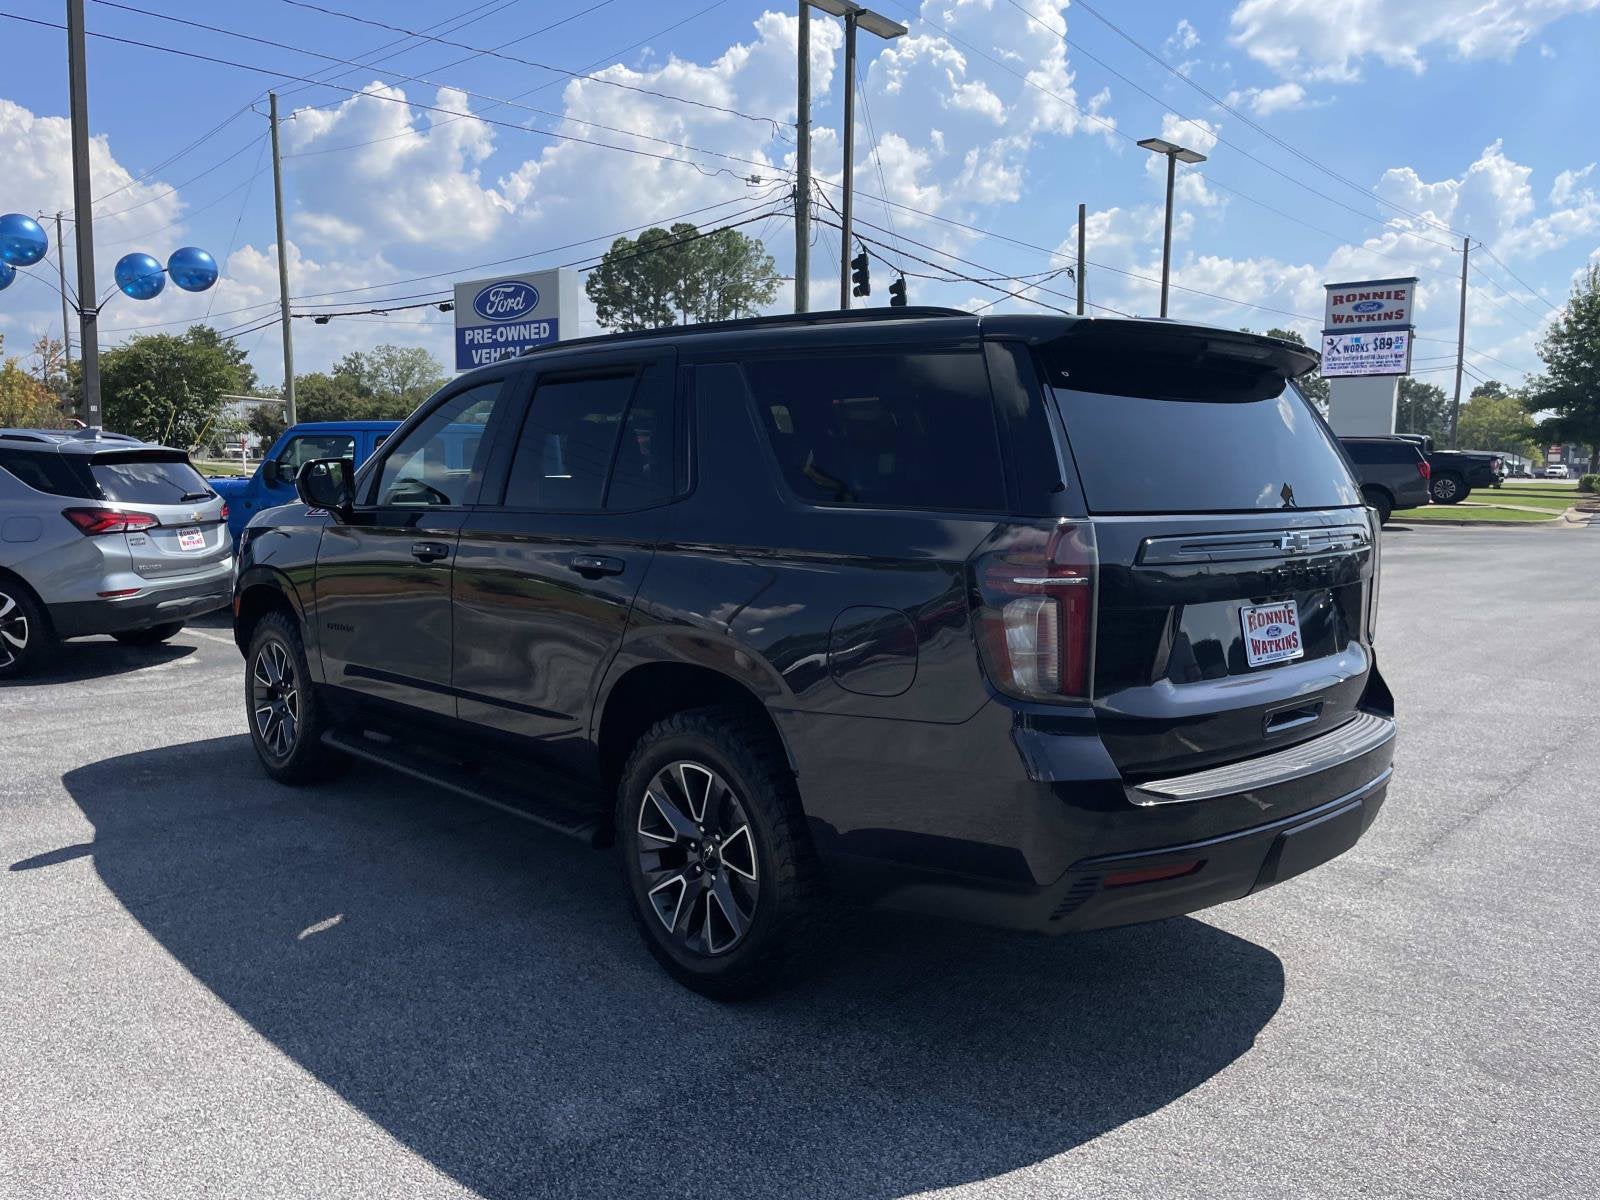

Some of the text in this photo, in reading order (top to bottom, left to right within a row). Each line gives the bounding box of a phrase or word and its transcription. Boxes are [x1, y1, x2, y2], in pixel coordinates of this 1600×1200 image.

[486, 286, 526, 315] Ford
[1332, 289, 1406, 306] RONNIE
[1331, 309, 1405, 325] WATKINS
[464, 322, 550, 345] PRE-OWNED
[471, 345, 540, 364] VEHCL
[1343, 342, 1369, 354] WORKS
[1247, 608, 1296, 633] RONNIE
[1251, 631, 1299, 656] WATKINS
